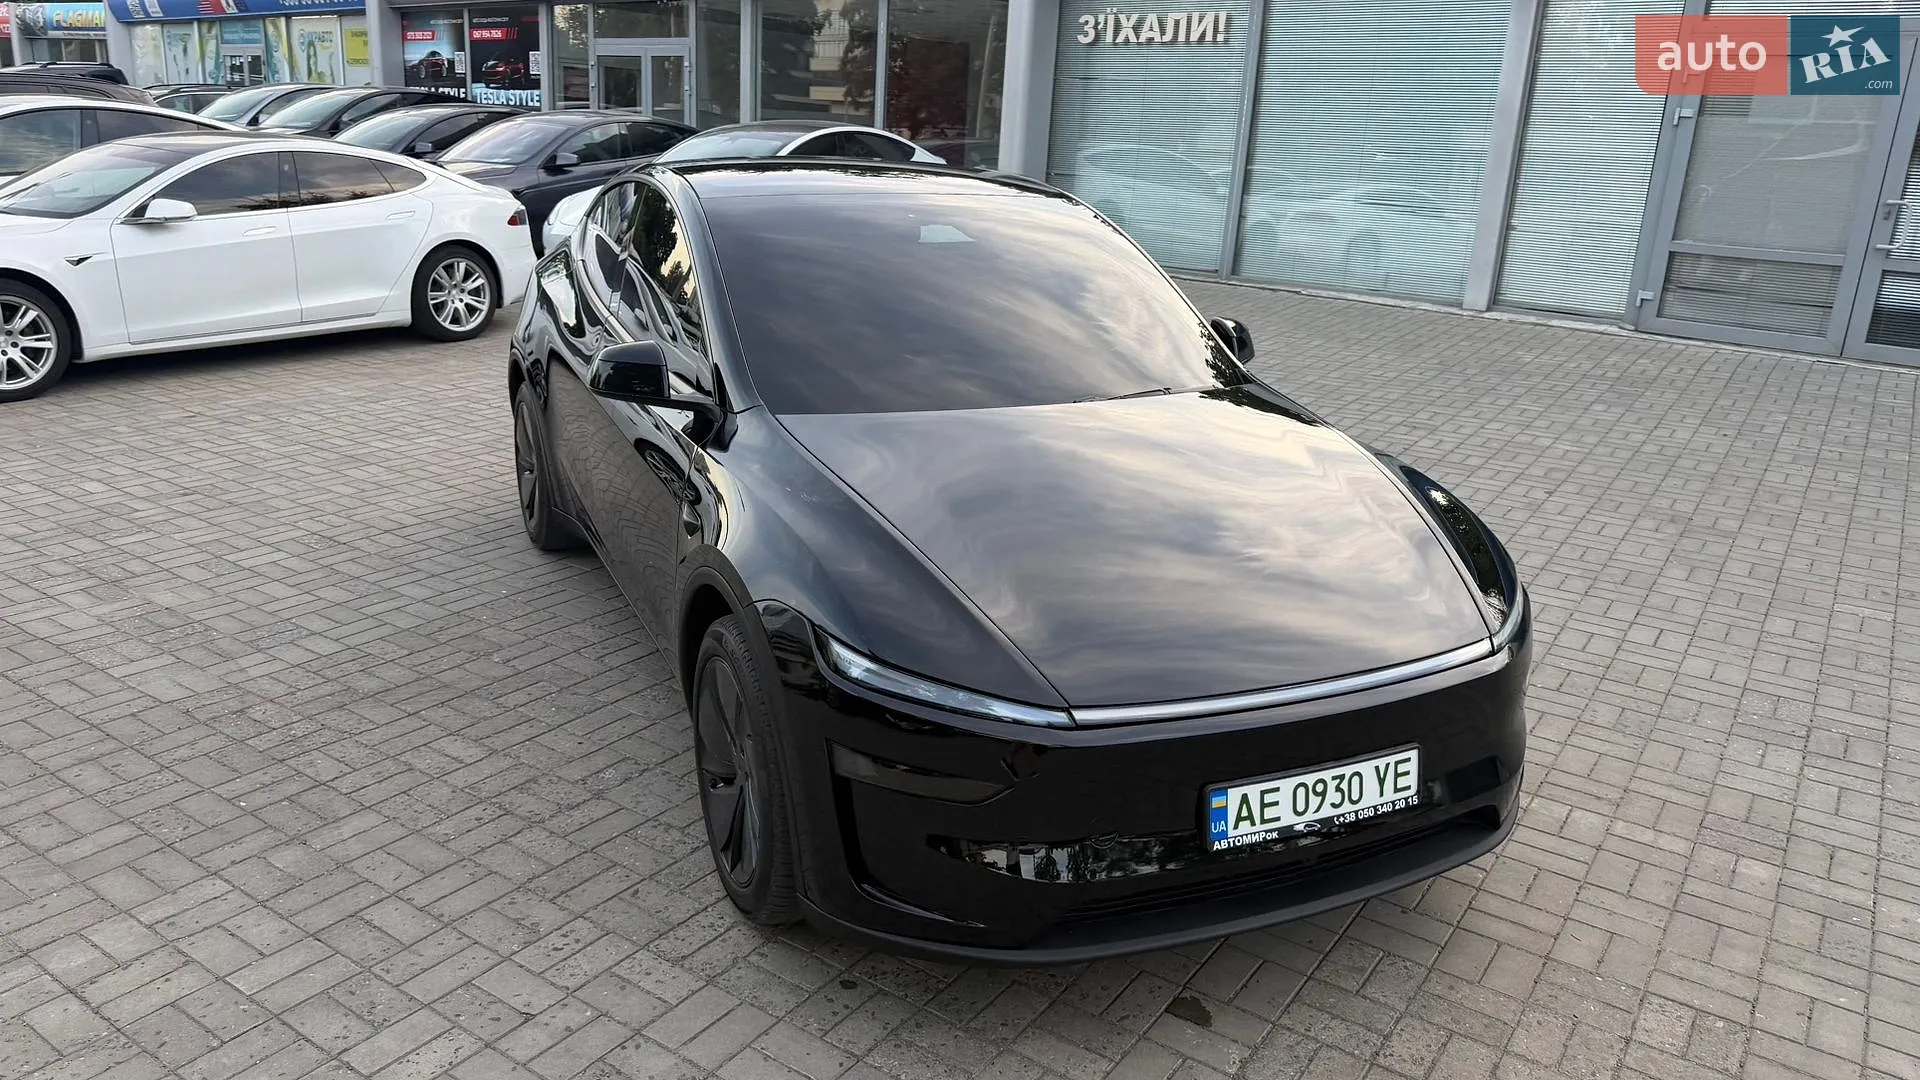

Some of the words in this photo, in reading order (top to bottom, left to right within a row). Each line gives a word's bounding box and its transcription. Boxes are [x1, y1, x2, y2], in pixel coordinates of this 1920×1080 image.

[476, 90, 507, 105] TESLA
[508, 91, 540, 107] STYLE
[1233, 786, 1282, 831] AE
[1293, 770, 1364, 817] 0930
[1374, 756, 1412, 798] YE
[1339, 812, 1356, 824] +38
[1358, 807, 1375, 820] 050
[1376, 802, 1393, 815] 340
[1394, 799, 1406, 810] 20
[1407, 795, 1418, 806] 15
[1211, 820, 1227, 833] UA
